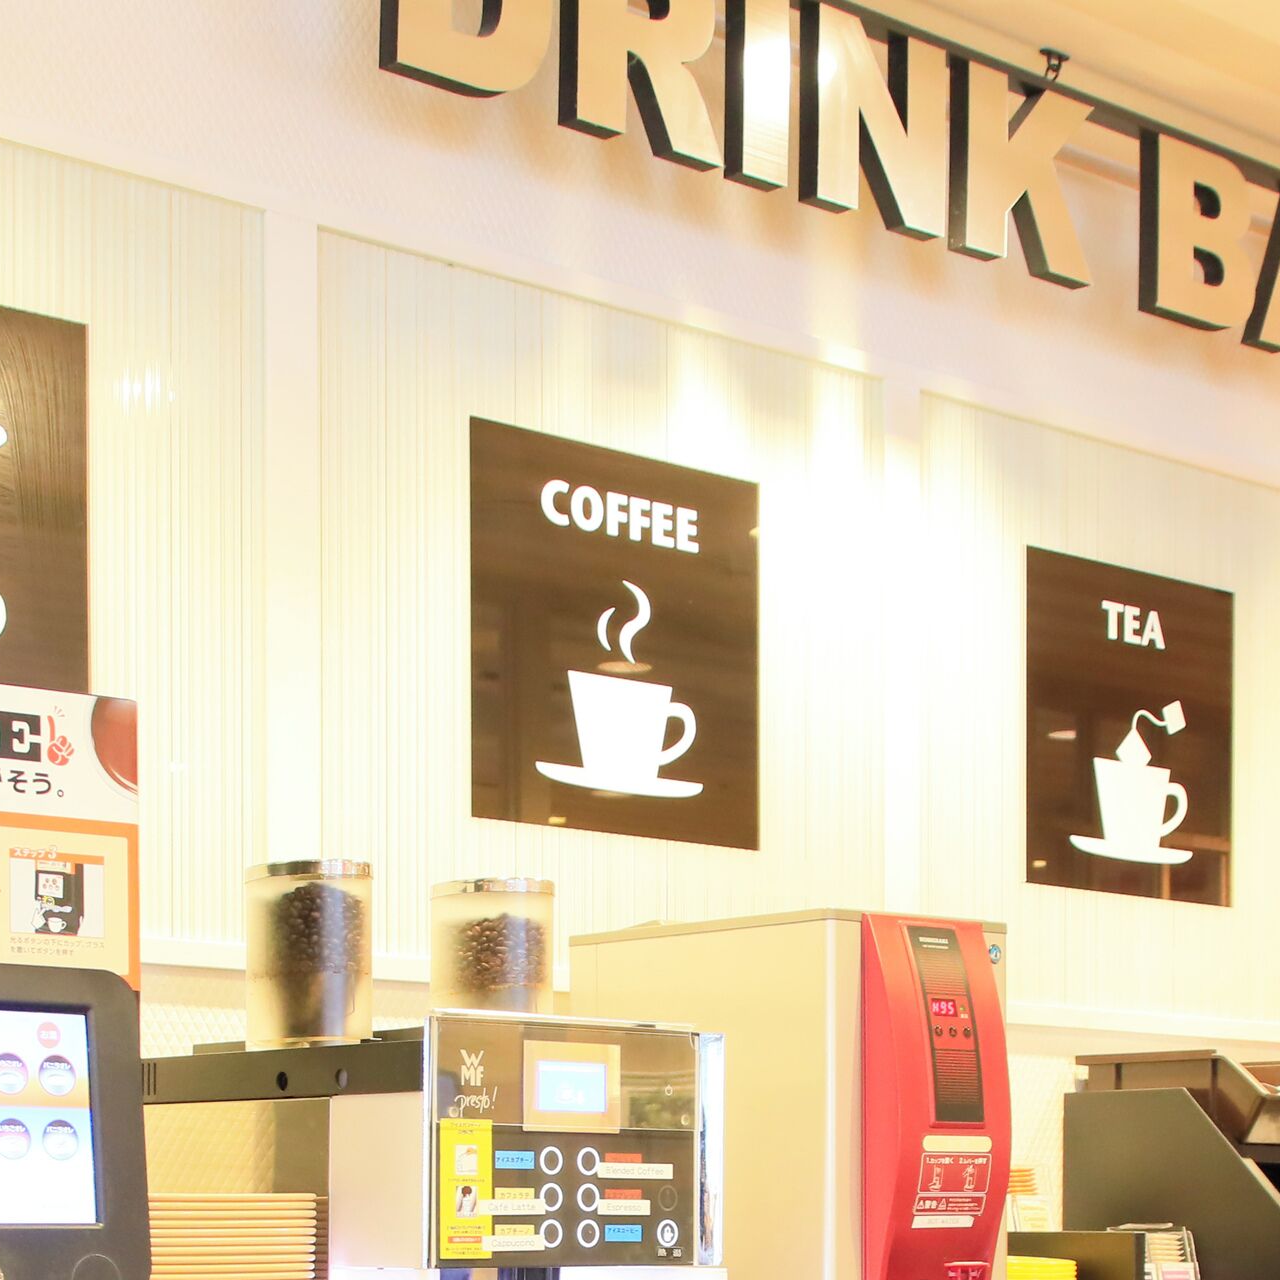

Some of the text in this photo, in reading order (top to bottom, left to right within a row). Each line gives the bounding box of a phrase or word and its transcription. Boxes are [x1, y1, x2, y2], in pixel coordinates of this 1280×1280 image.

[540, 479, 700, 554] COFFEE
[1101, 599, 1166, 650] TEA
[460, 1049, 485, 1087] WMF
[637, 1166, 665, 1176] Coffee
